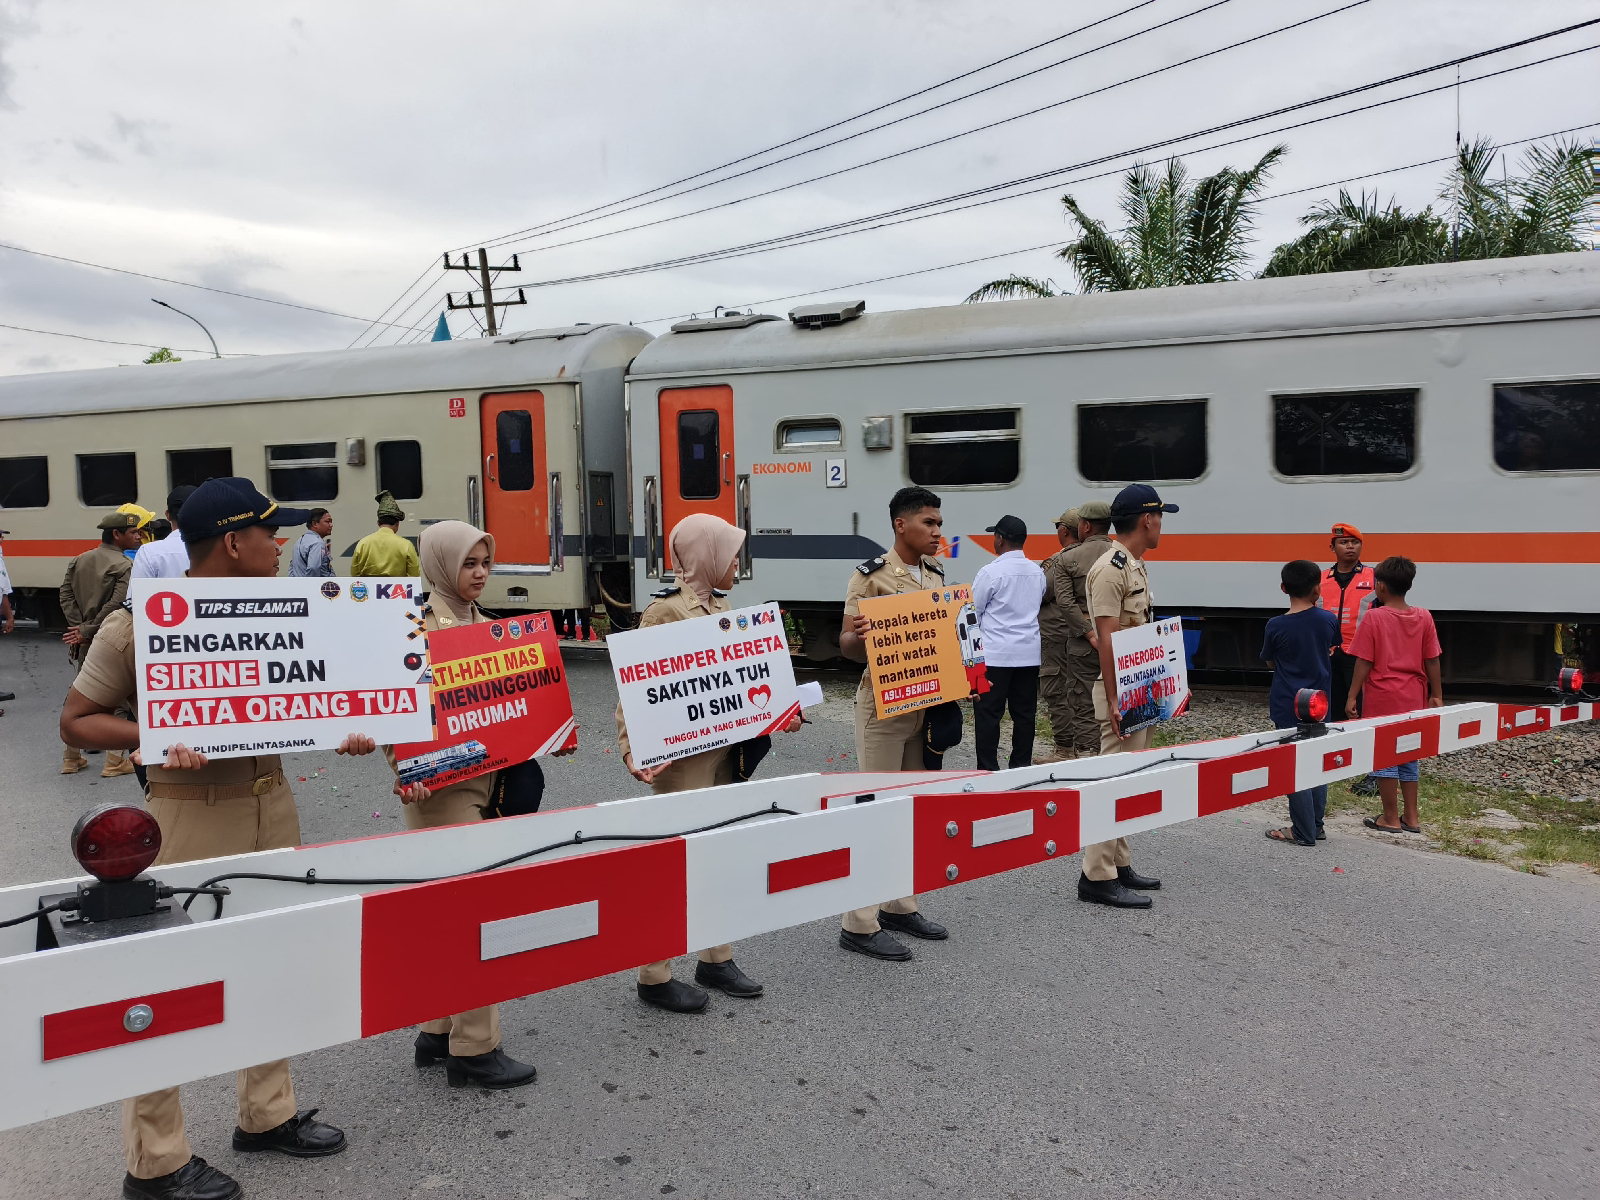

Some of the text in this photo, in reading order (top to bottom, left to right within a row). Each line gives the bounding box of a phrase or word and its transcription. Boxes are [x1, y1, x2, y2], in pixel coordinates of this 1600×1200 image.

[752, 461, 812, 475] EKONOMI
[831, 465, 841, 481] 2
[200, 601, 304, 614] TIPS SELAMAT!
[870, 607, 948, 631] kepala kereta
[149, 631, 304, 654] DENGARKAN
[872, 628, 937, 649] lebih keras
[503, 647, 540, 671] MAS
[619, 635, 784, 684] MENEMPER KERETA
[876, 644, 937, 667] dari watak
[1117, 645, 1165, 671] MENEROBOS
[149, 660, 326, 690] SIRINE DAN
[646, 662, 770, 705] SAKITNYA TUH
[878, 663, 940, 685] mantanmu
[1120, 664, 1166, 687] PERLINTASAN KA
[440, 666, 561, 711] MENUNGGUMU
[884, 680, 938, 702] ASLI, SERIUS!
[151, 689, 415, 728] KATA ORANG TUA
[447, 698, 528, 736] DIRUMAH
[687, 693, 744, 721] DI SINI
[663, 711, 772, 746] TUNGGU KA YANG MELINTAS
[162, 738, 316, 757] #PLINDIPELINTASANKA
